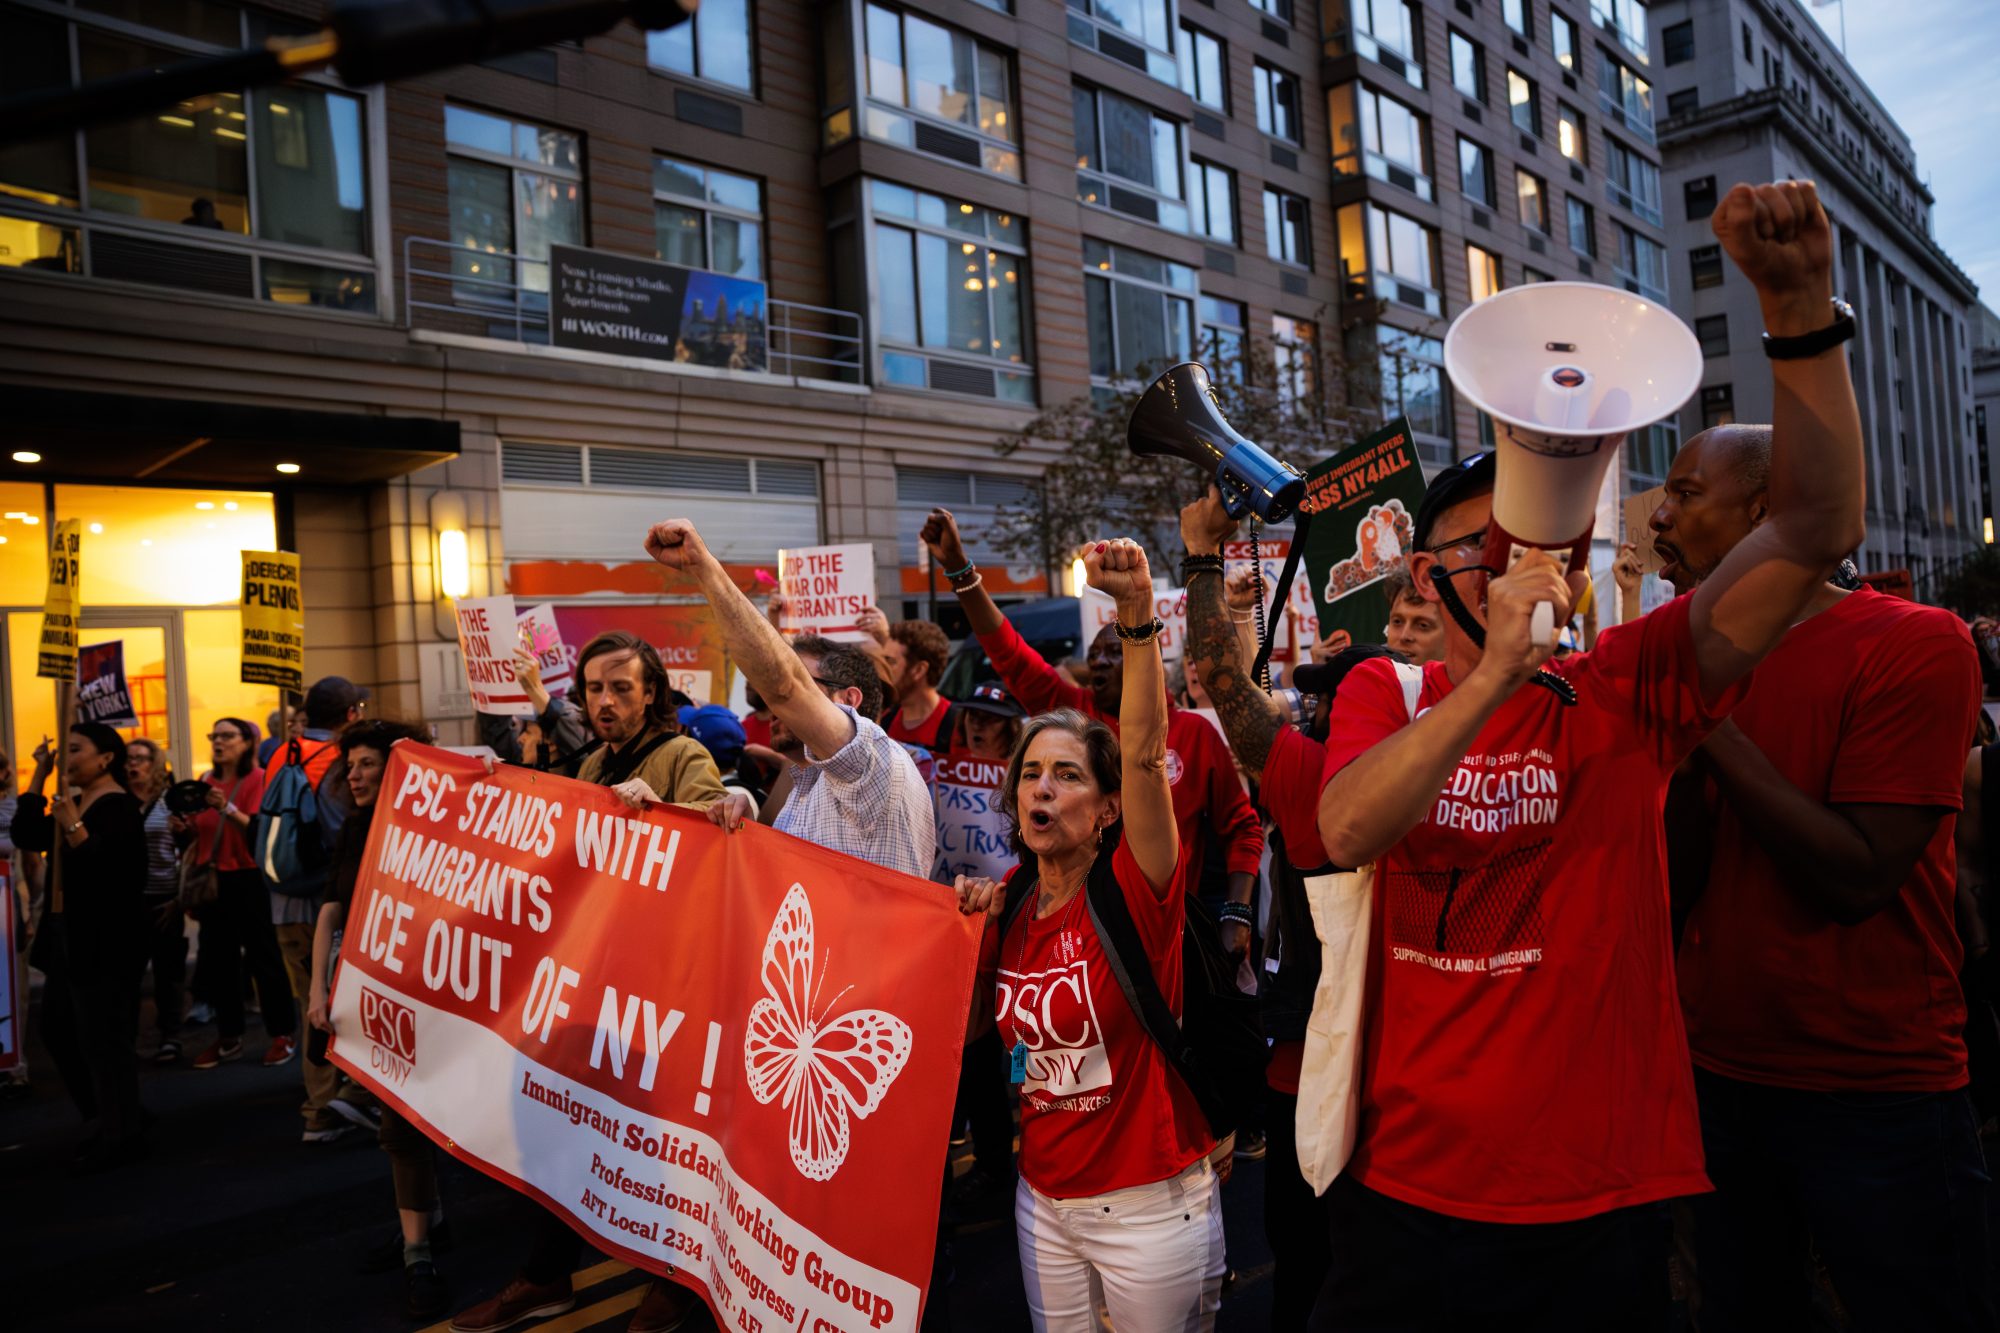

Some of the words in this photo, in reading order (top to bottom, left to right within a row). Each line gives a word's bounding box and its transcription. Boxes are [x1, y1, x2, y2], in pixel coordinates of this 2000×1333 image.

[1342, 448, 1411, 497] NY4ALL
[807, 553, 843, 575] THE
[814, 575, 838, 596] ON
[461, 608, 490, 632] THE
[472, 635, 492, 657] ON
[394, 763, 456, 824] PSC
[457, 781, 563, 859] STANDS
[575, 808, 681, 892] WITH
[378, 823, 553, 934] IMMIGRANTS
[1393, 947, 1428, 965] SUPPORT
[1454, 959, 1474, 973] AND
[359, 888, 415, 976] ICE
[422, 918, 512, 1014] OUT
[521, 956, 581, 1045] OF
[589, 985, 686, 1092] NY
[362, 988, 416, 1060] PSC
[371, 1045, 411, 1088] CUNY
[1025, 1054, 1087, 1086] UNY
[521, 1070, 620, 1144] Immigrant
[623, 1123, 726, 1204] Solidarity
[726, 1179, 800, 1276] Working
[803, 1251, 894, 1330] Group
[580, 1188, 608, 1220] AFT
[608, 1206, 659, 1243] Local
[662, 1228, 703, 1263] 2334
[590, 1152, 710, 1227] Professional
[711, 1210, 729, 1258] Staff
[728, 1244, 796, 1324] Congress
